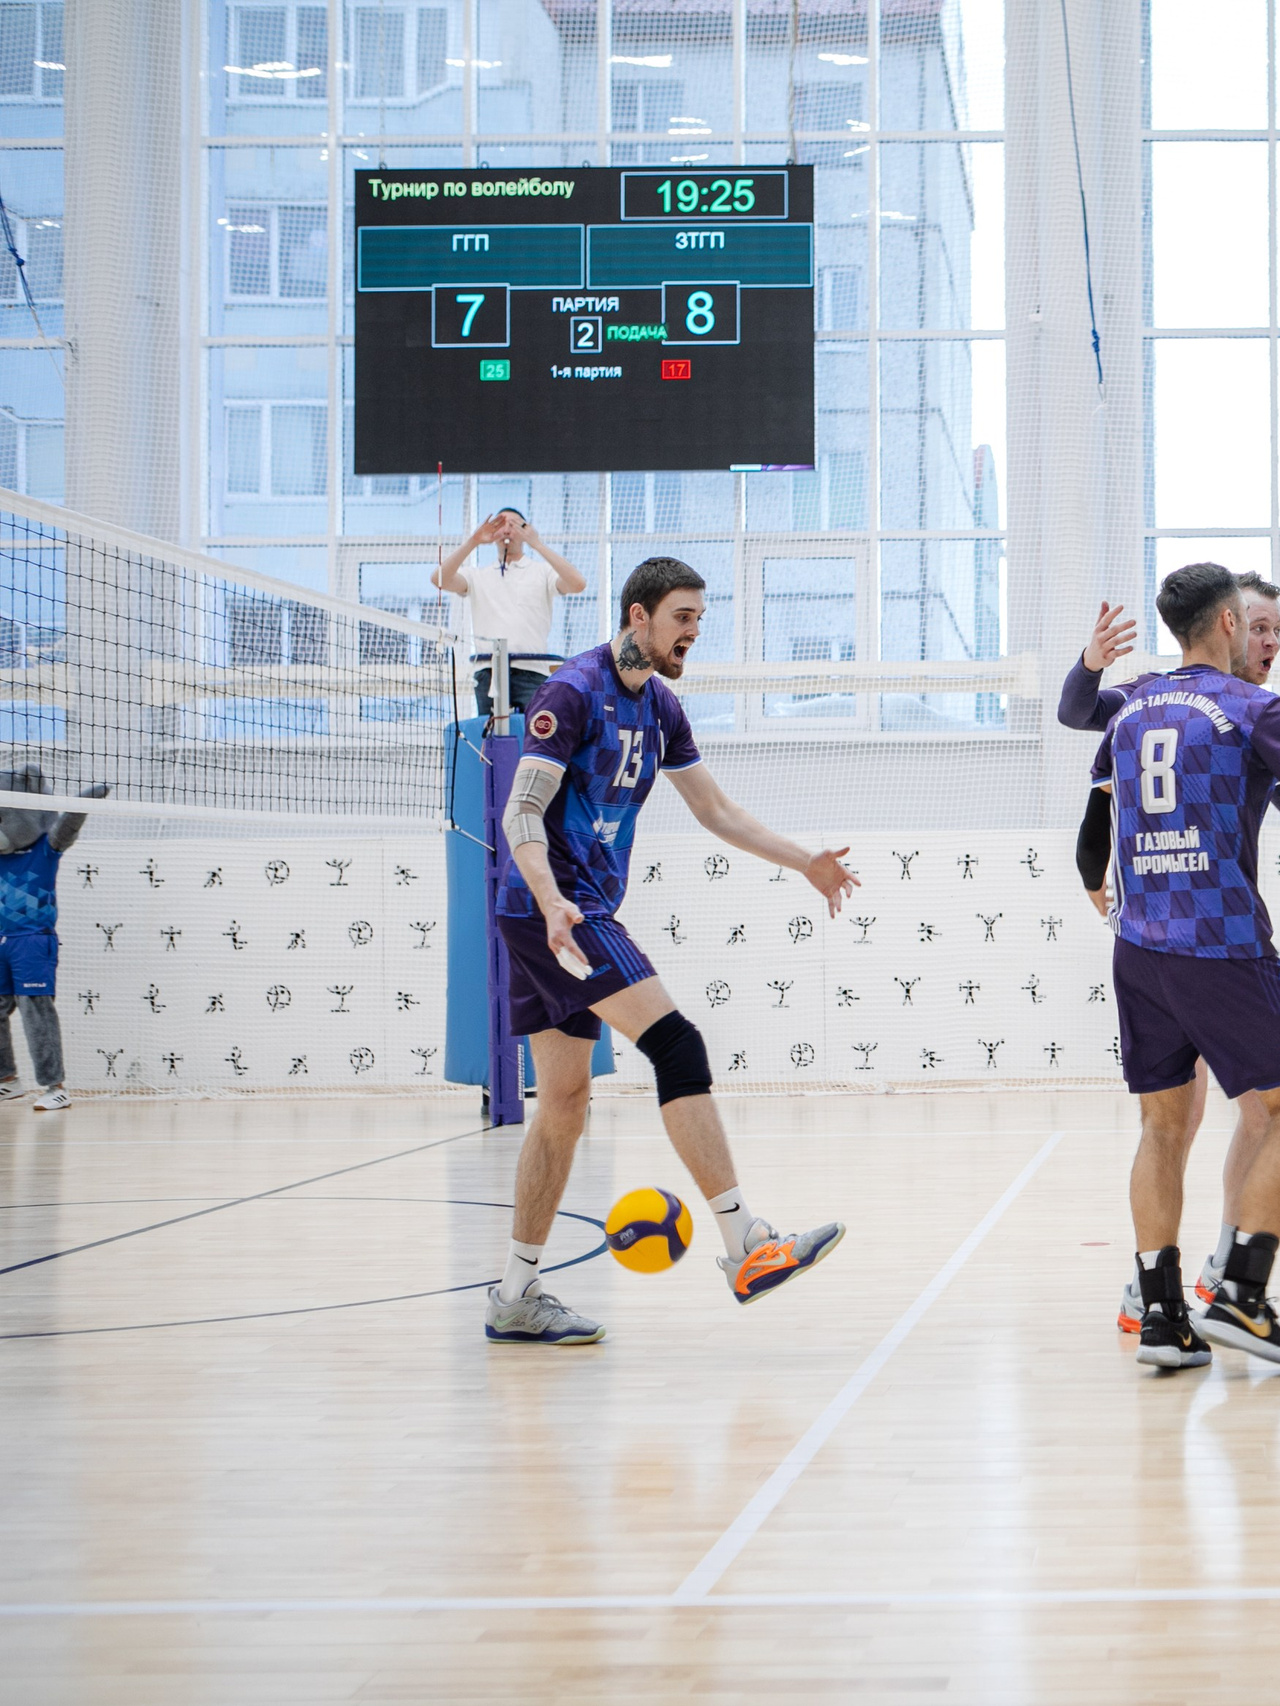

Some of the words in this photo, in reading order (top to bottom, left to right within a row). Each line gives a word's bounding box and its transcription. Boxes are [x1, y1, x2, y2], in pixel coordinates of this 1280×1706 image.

[368, 178, 439, 201] Турнир
[443, 181, 467, 197] по
[471, 177, 575, 199] волейболу
[657, 179, 755, 213] 19:25
[452, 234, 489, 252] ГГП
[675, 231, 725, 249] ЗТГП
[456, 293, 485, 337] 7
[552, 296, 620, 313] ПАРТИЯ
[685, 290, 715, 335] 8
[577, 322, 594, 348] 2
[606, 325, 668, 342] ПОДАЧА
[486, 363, 505, 378] 25
[550, 364, 572, 379] 1-я
[574, 366, 622, 381] партия
[667, 363, 686, 377] 17
[612, 729, 644, 788] 13
[1140, 728, 1179, 815] 8
[1135, 825, 1201, 852] ГАЗОВЫЙ
[1132, 852, 1209, 876] ПРОМЫСЕЛ
